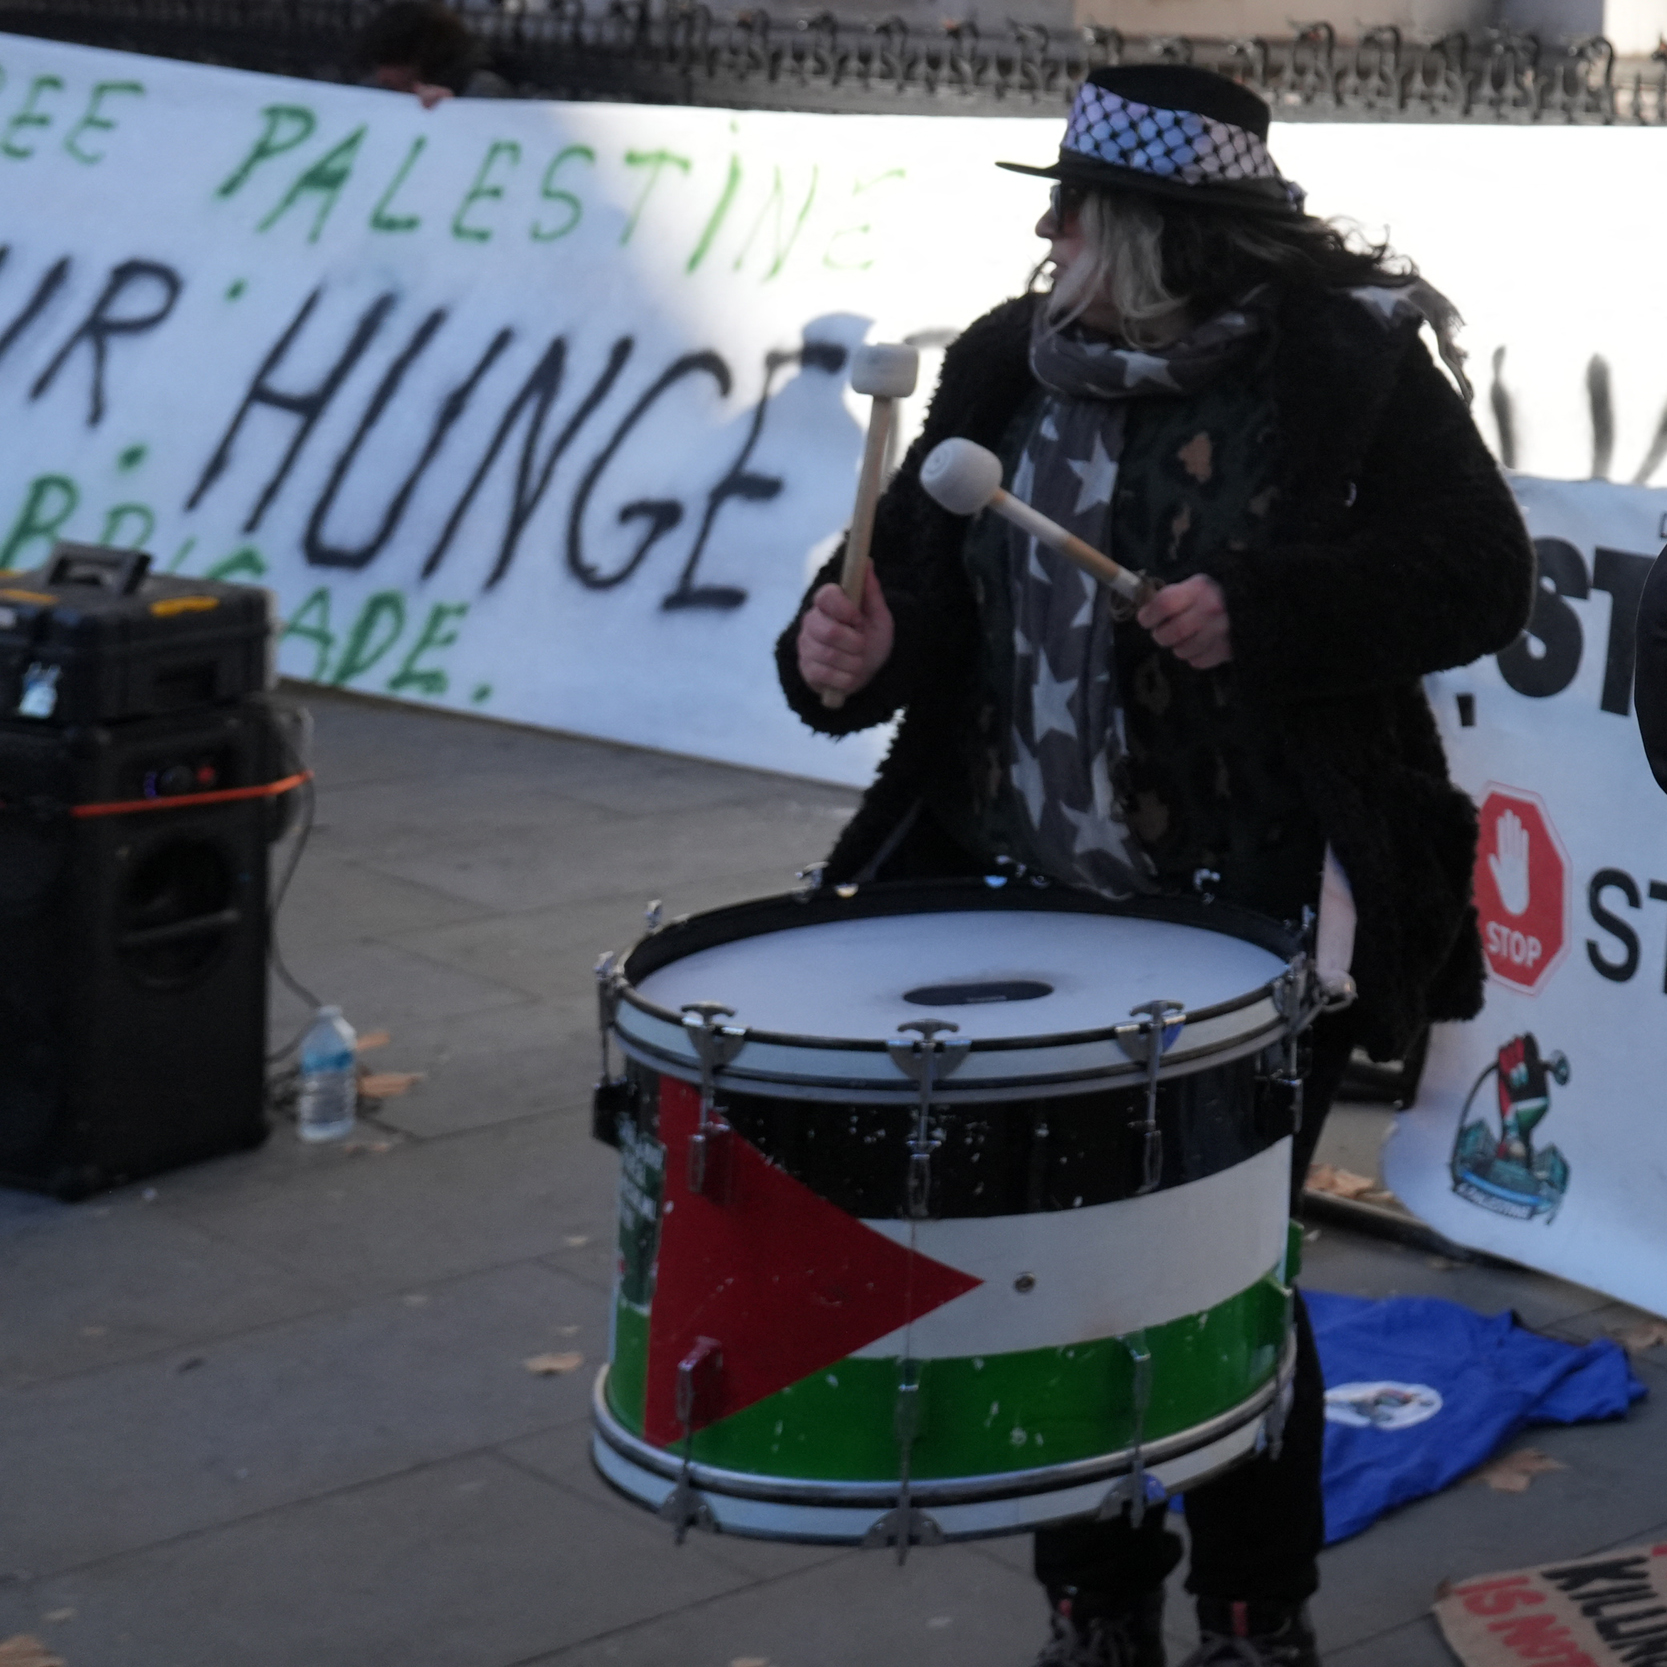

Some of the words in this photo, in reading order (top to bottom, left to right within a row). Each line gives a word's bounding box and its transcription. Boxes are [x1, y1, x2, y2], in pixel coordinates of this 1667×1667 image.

[0, 69, 146, 165] EE
[184, 284, 962, 612] HUNGE
[1497, 535, 1658, 718] ST
[1485, 920, 1543, 969] STOP
